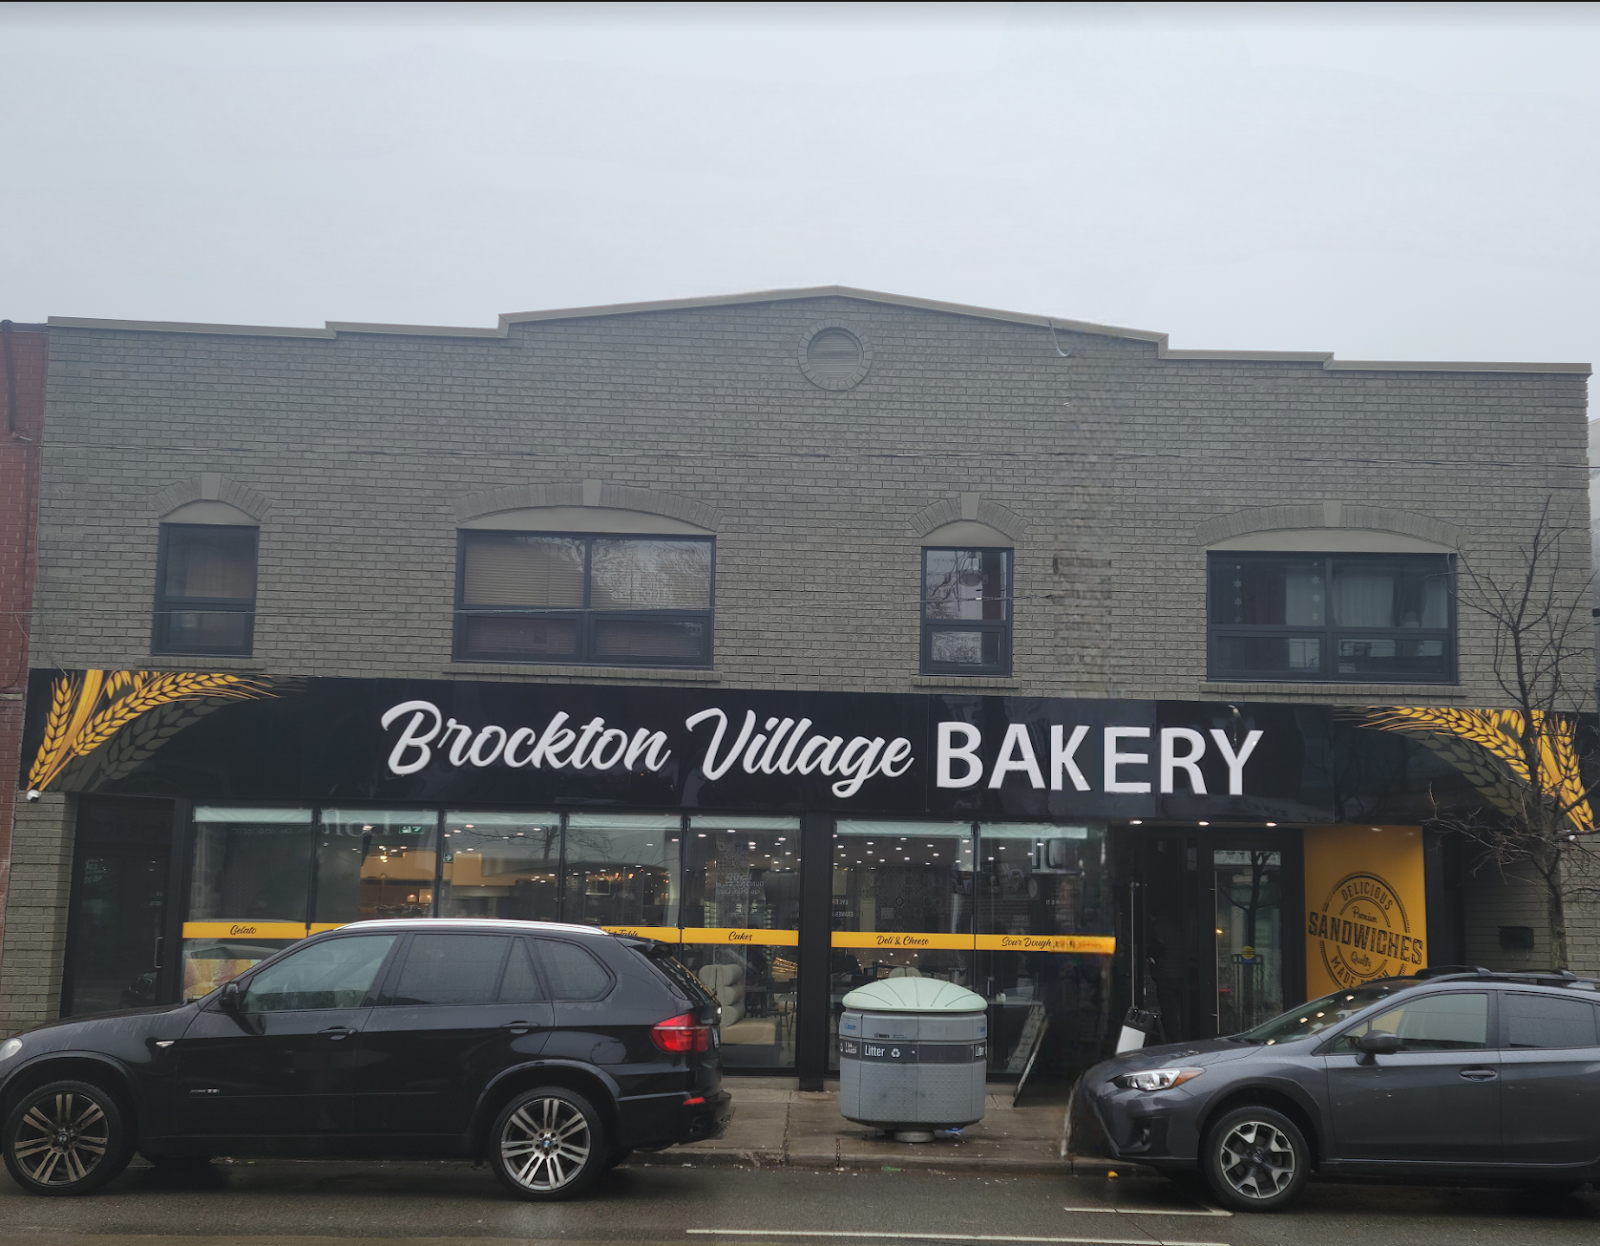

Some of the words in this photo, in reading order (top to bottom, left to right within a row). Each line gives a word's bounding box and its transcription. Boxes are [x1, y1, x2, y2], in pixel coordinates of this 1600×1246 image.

[380, 699, 672, 775] Brockton
[685, 707, 915, 799] Village
[936, 720, 1265, 796] BAKERY
[1340, 881, 1393, 911] DELICIOUS
[1352, 905, 1378, 923] Premium
[230, 925, 257, 936] Gelato
[728, 931, 753, 942] Cakes
[1308, 911, 1424, 966] SANDWICHES
[876, 935, 894, 946] Deli
[894, 936, 901, 946] &
[902, 935, 930, 946] Cheese
[1001, 936, 1022, 947] Sour
[1023, 937, 1052, 949] Dough
[1351, 951, 1372, 972] Quality
[1331, 955, 1357, 988] MADE
[864, 1044, 886, 1057] Litter
